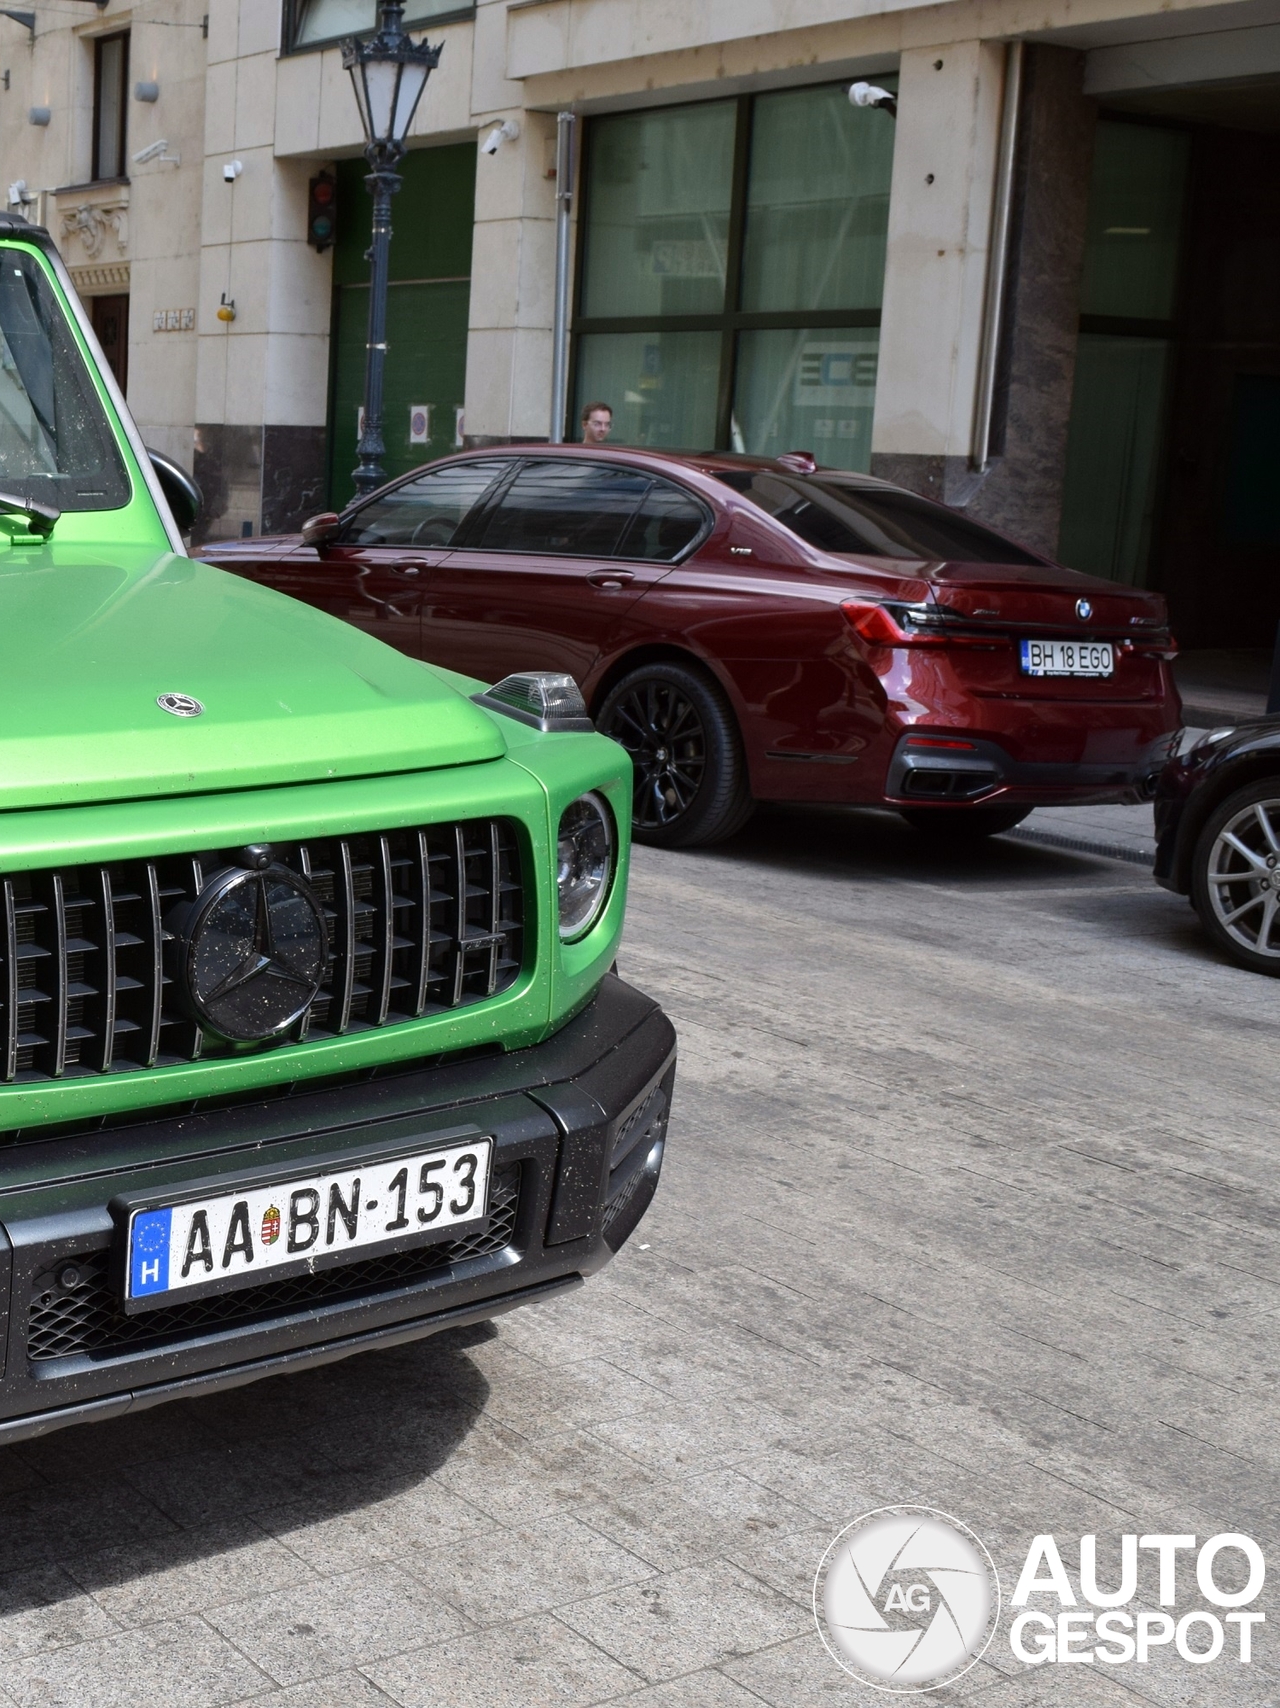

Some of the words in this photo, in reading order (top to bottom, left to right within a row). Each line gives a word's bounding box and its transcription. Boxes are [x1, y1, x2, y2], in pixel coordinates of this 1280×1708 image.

[1031, 644, 1054, 668] BH
[1060, 645, 1075, 668] 18
[1079, 646, 1111, 669] EGO
[180, 1200, 255, 1278] AA
[286, 1153, 478, 1254] BN-153
[141, 1258, 159, 1285] H
